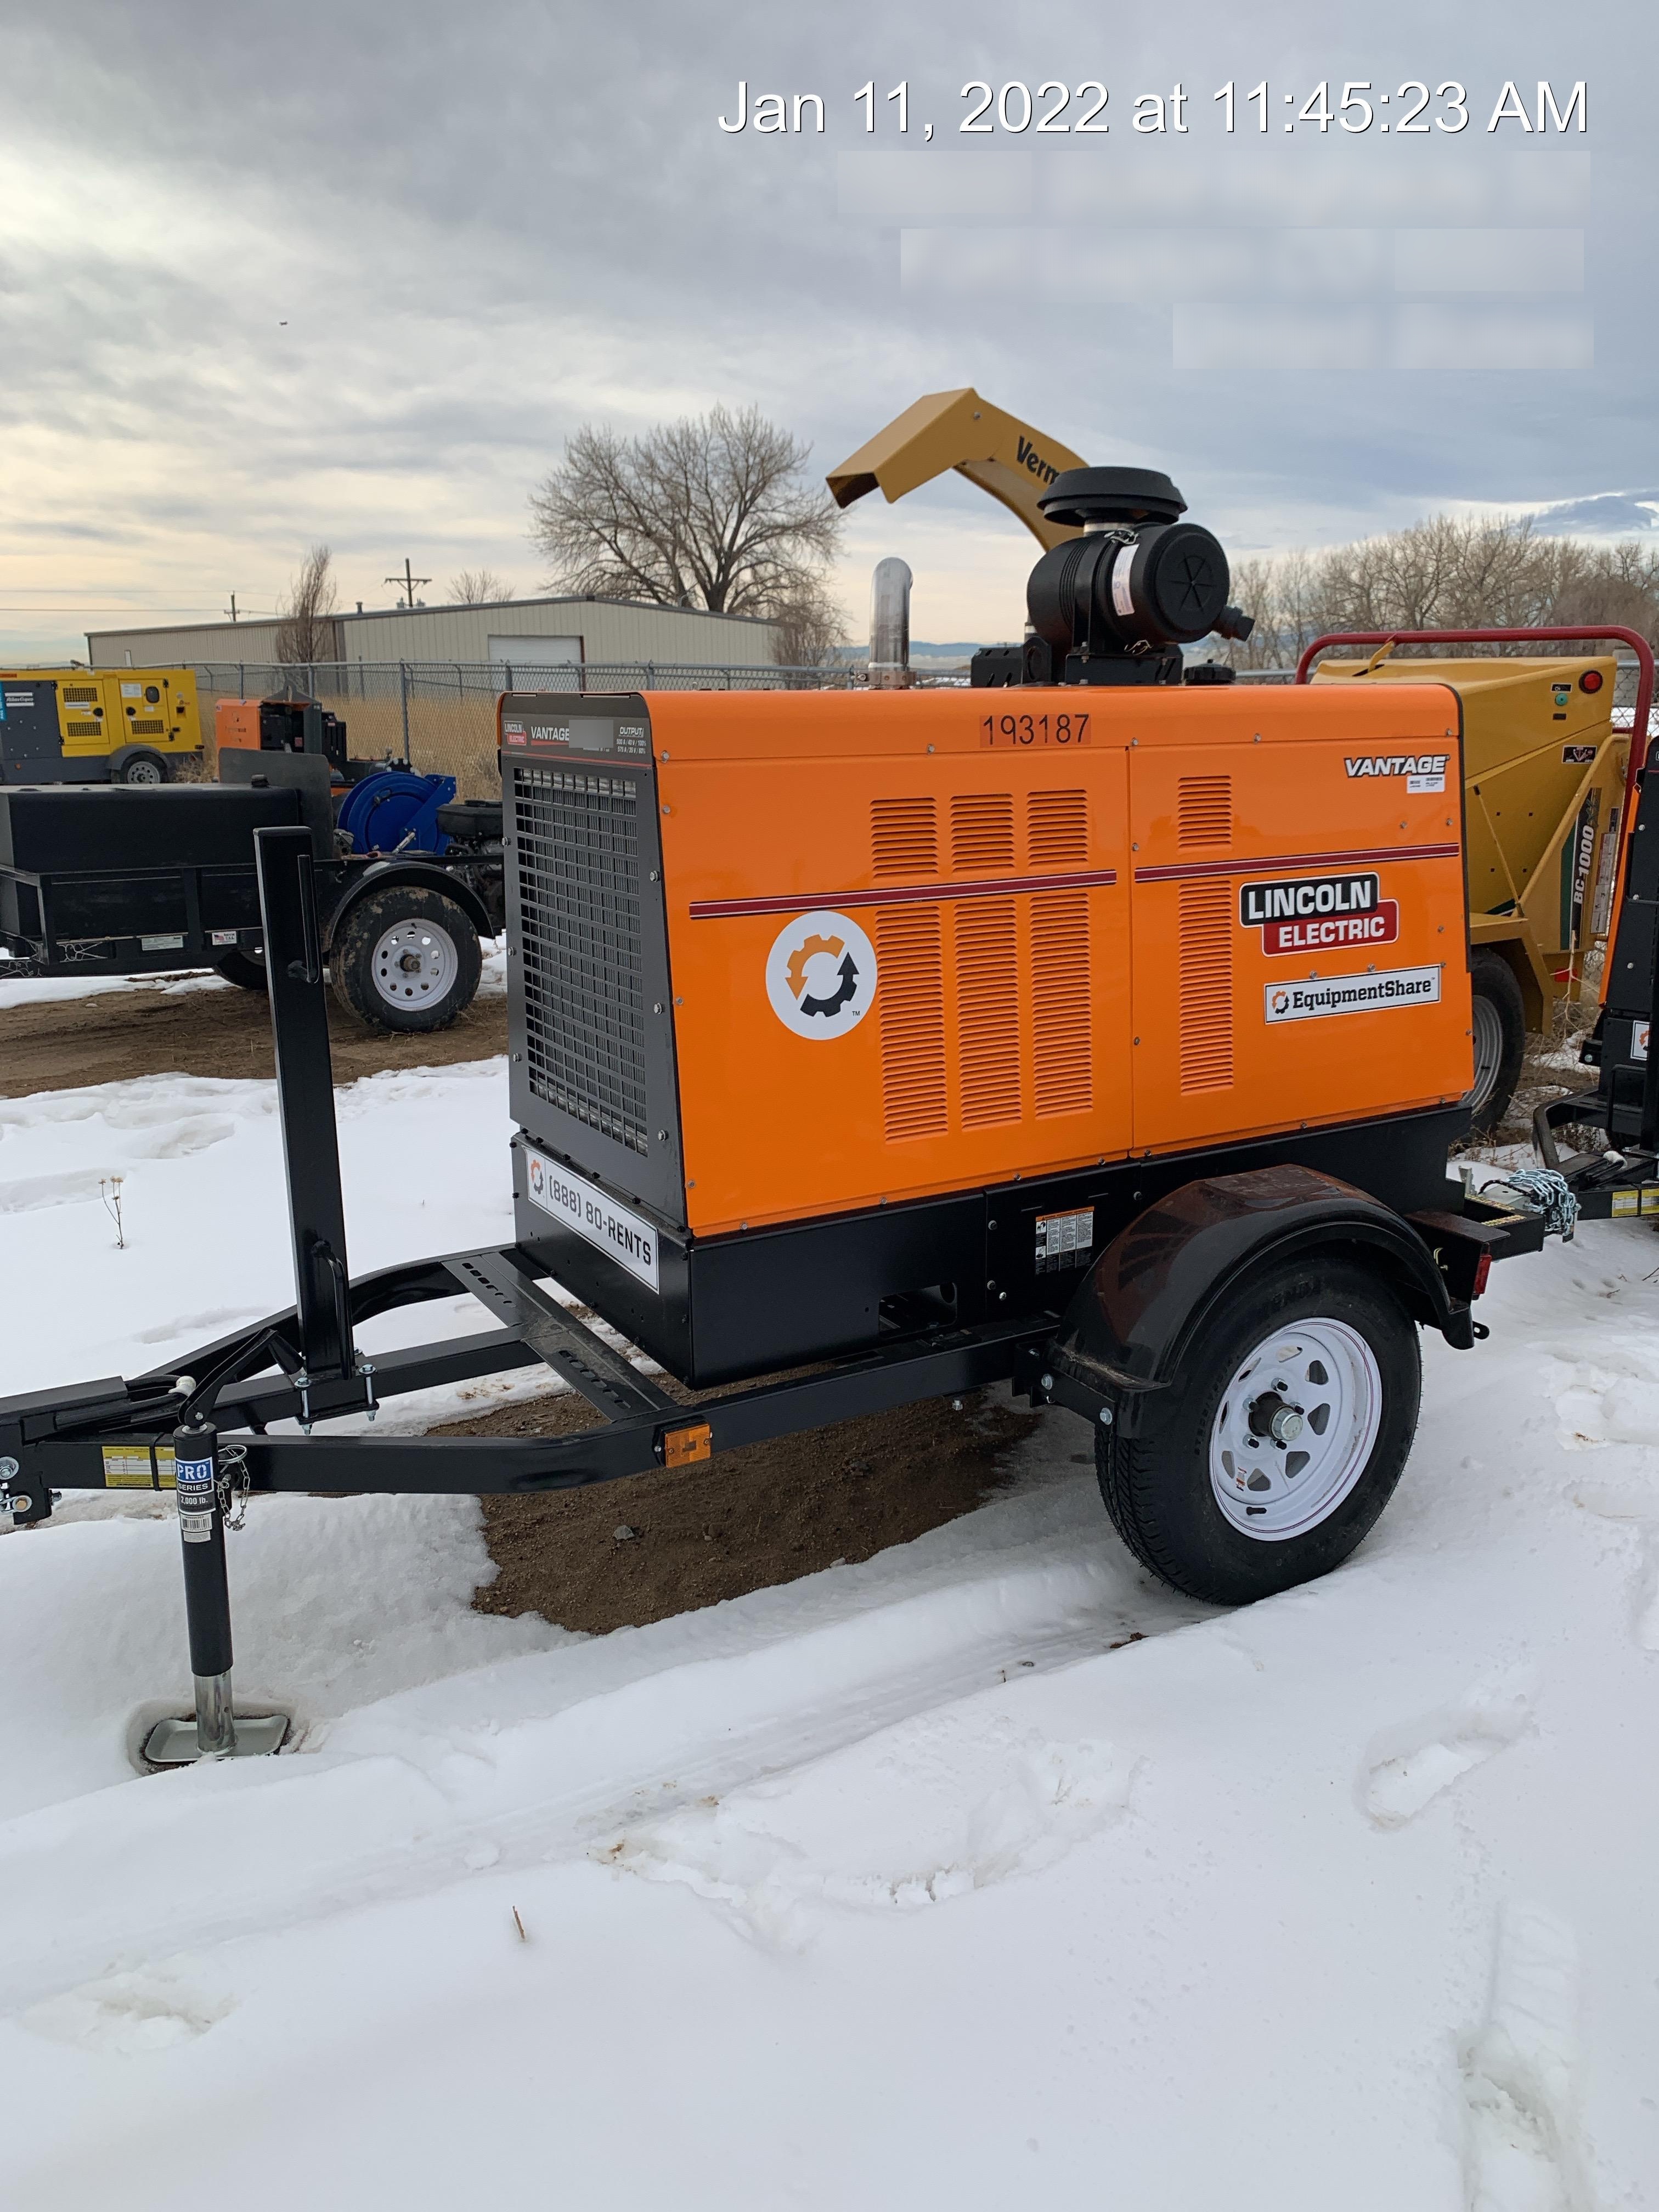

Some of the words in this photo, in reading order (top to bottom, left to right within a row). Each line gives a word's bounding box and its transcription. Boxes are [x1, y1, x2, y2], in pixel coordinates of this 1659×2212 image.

[505, 723, 522, 733] LINCOLN
[531, 726, 569, 741] VANTAGE
[619, 727, 642, 735] OUTPUT
[983, 714, 1089, 745] 193187
[1344, 755, 1447, 777] VANTAGE
[1249, 881, 1372, 920] LINCOLN
[1279, 917, 1385, 948] ELECTRIC
[1293, 979, 1432, 1011] EquipmentShare
[549, 1175, 582, 1217] (888)
[586, 1201, 651, 1266] 80-RENTS
[177, 1464, 207, 1480] PRO
[180, 1496, 198, 1505] 2,000
